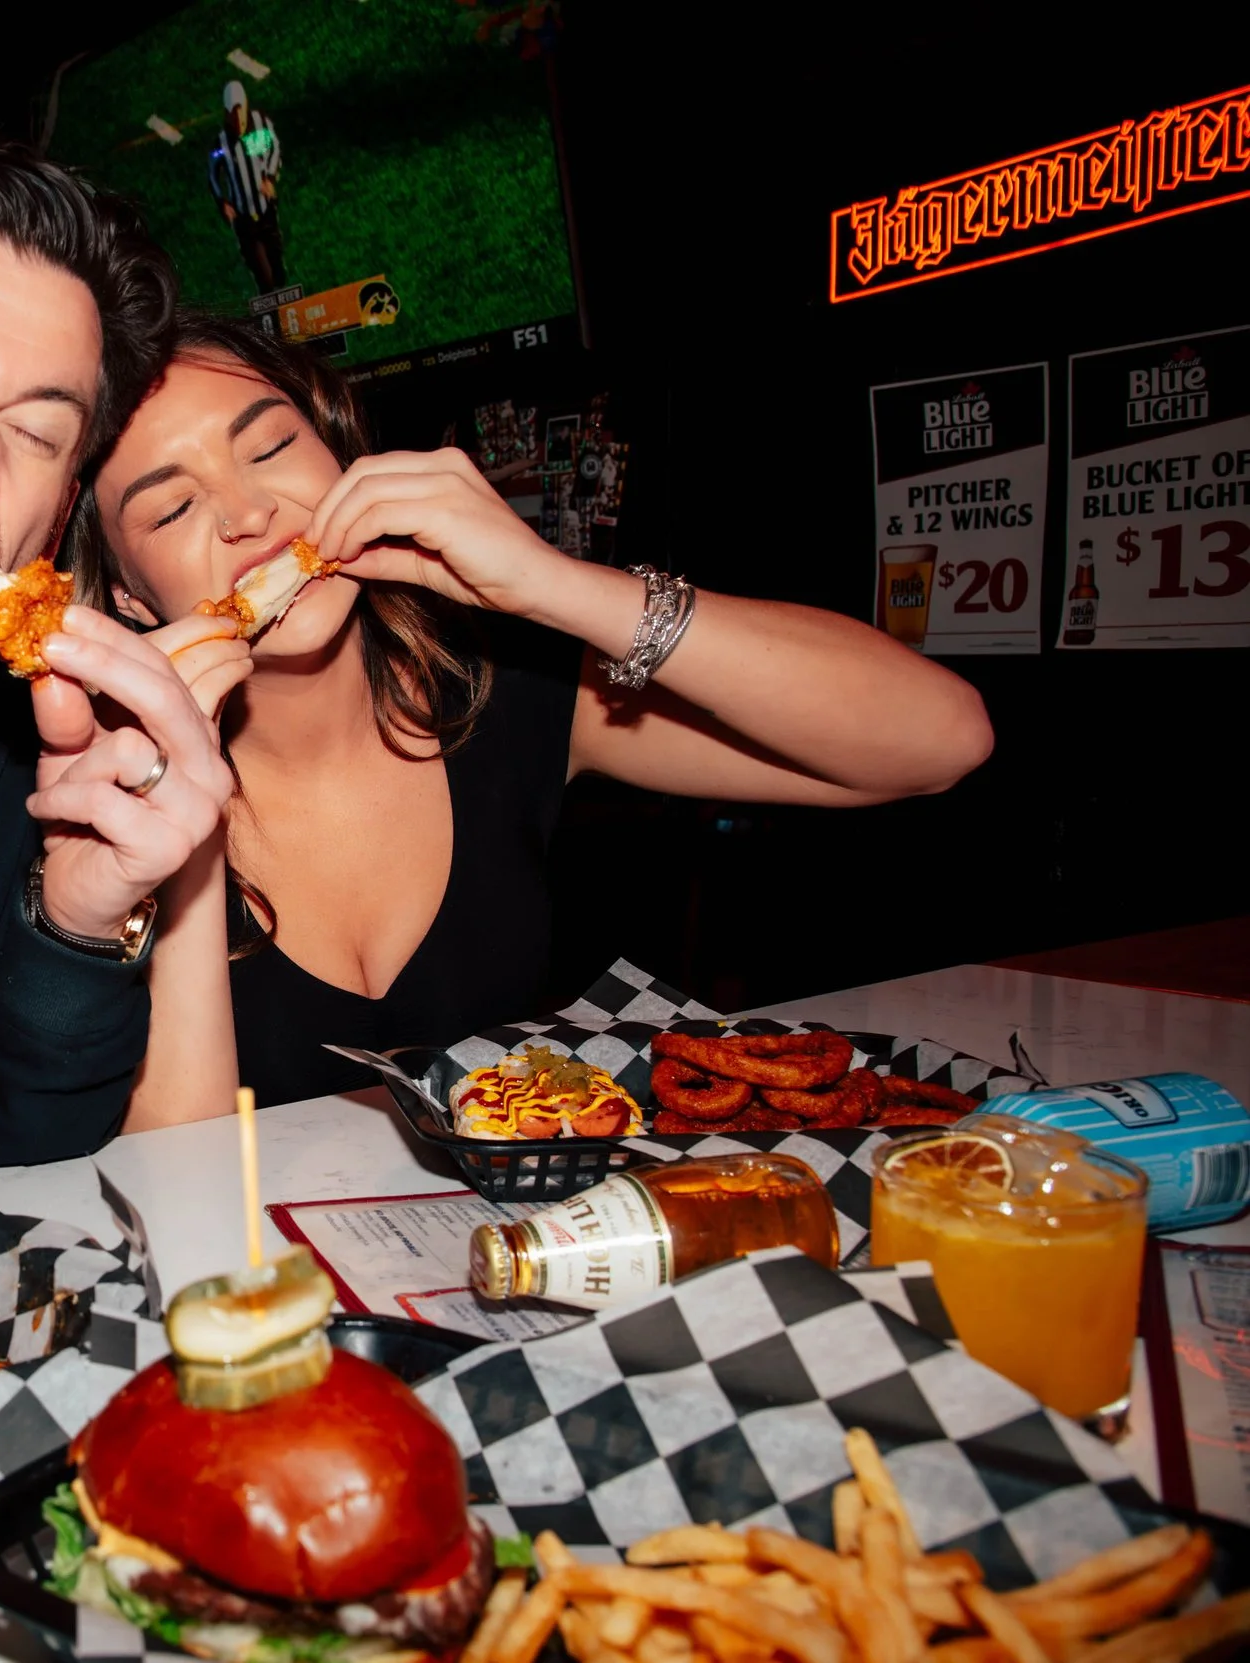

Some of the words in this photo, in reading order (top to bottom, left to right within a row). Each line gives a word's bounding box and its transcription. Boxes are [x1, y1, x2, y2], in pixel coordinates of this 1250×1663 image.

[512, 323, 548, 350] FS1
[1129, 366, 1206, 399] Blue
[923, 400, 990, 428] Blue
[1128, 392, 1208, 427] LIGHT
[924, 423, 992, 453] LIGHT
[1087, 455, 1201, 490] BUCKET
[1212, 450, 1250, 477] OF
[908, 478, 1011, 508] PITCHER
[1083, 490, 1155, 519] BLUE
[886, 515, 903, 536] &
[914, 512, 942, 534] 12
[951, 503, 1033, 531] WINGS
[938, 558, 1029, 614] $20
